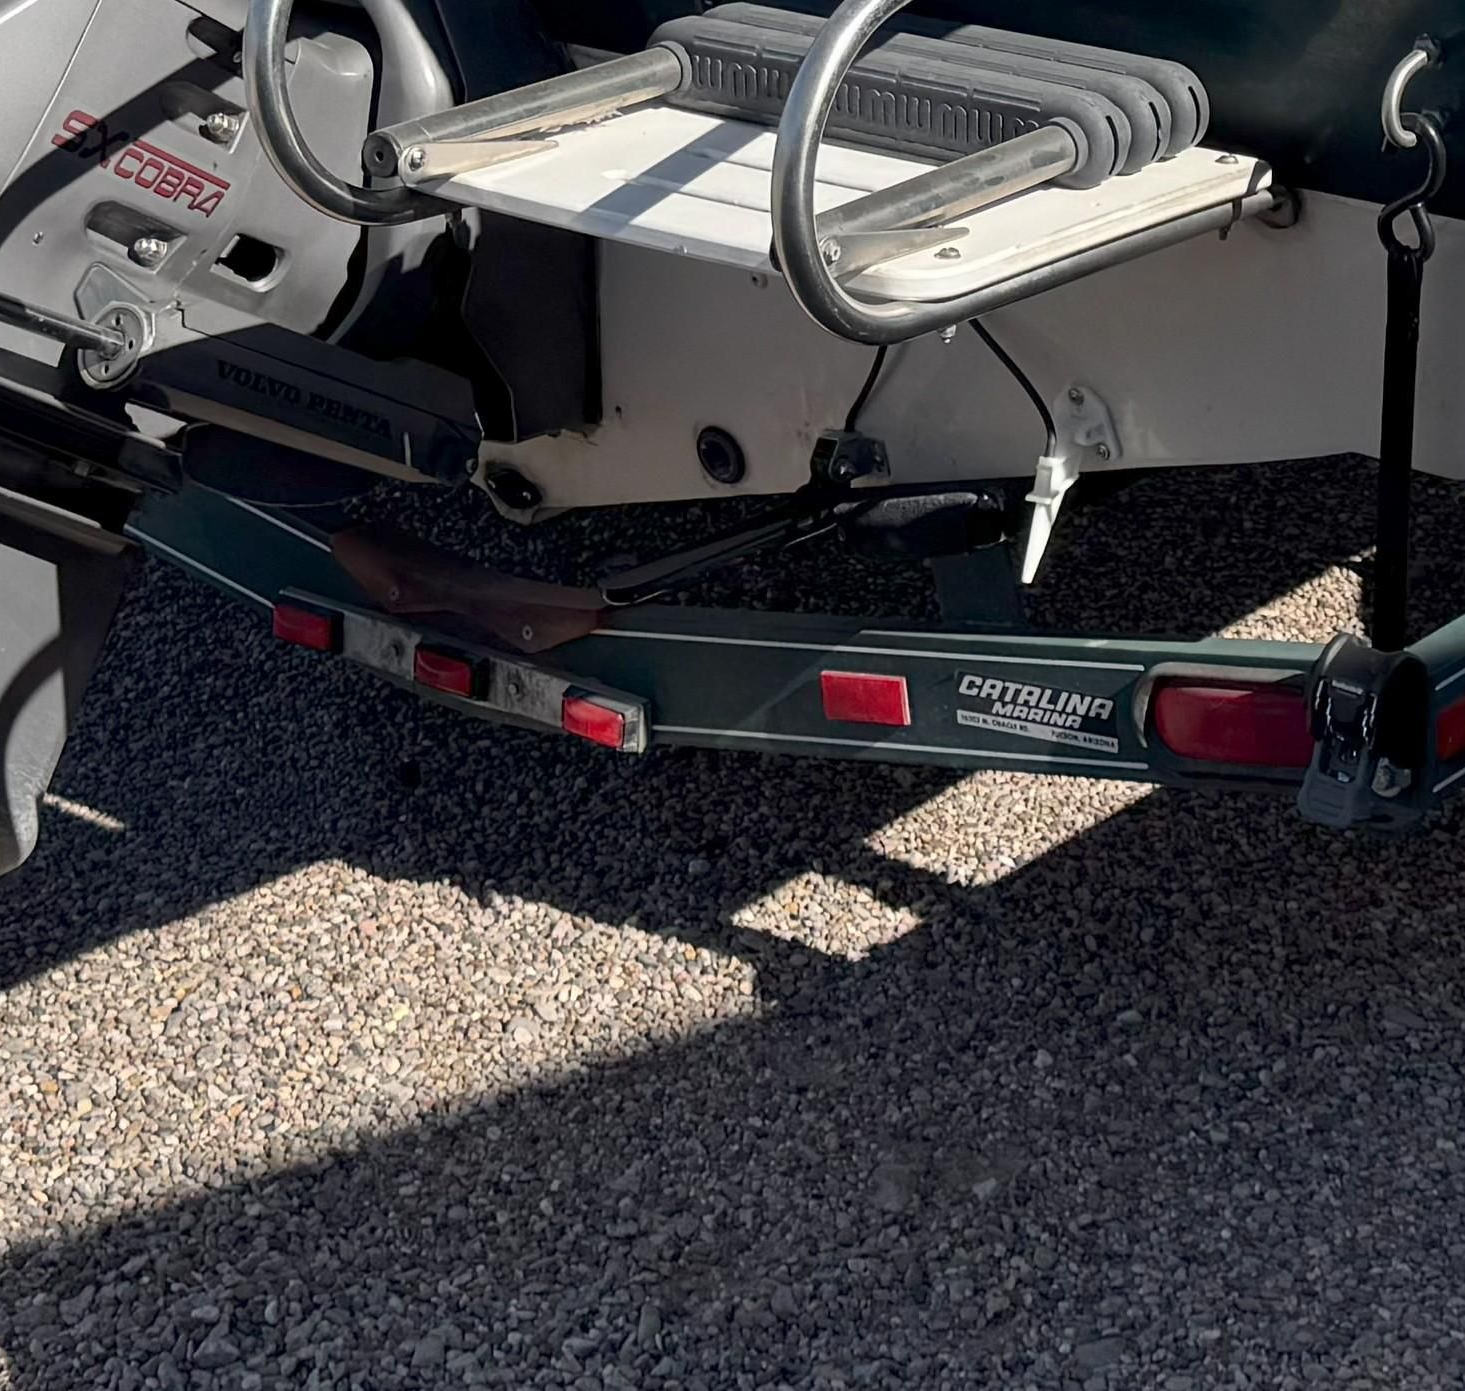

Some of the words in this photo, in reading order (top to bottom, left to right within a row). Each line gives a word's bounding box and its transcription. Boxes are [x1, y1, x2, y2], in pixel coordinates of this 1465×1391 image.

[51, 109, 131, 169] SX
[113, 147, 225, 218] COBRA
[216, 359, 302, 405] VOLVO
[306, 391, 393, 439] PENTA
[958, 674, 1114, 720] CATALINA
[991, 701, 1083, 729] MARINA
